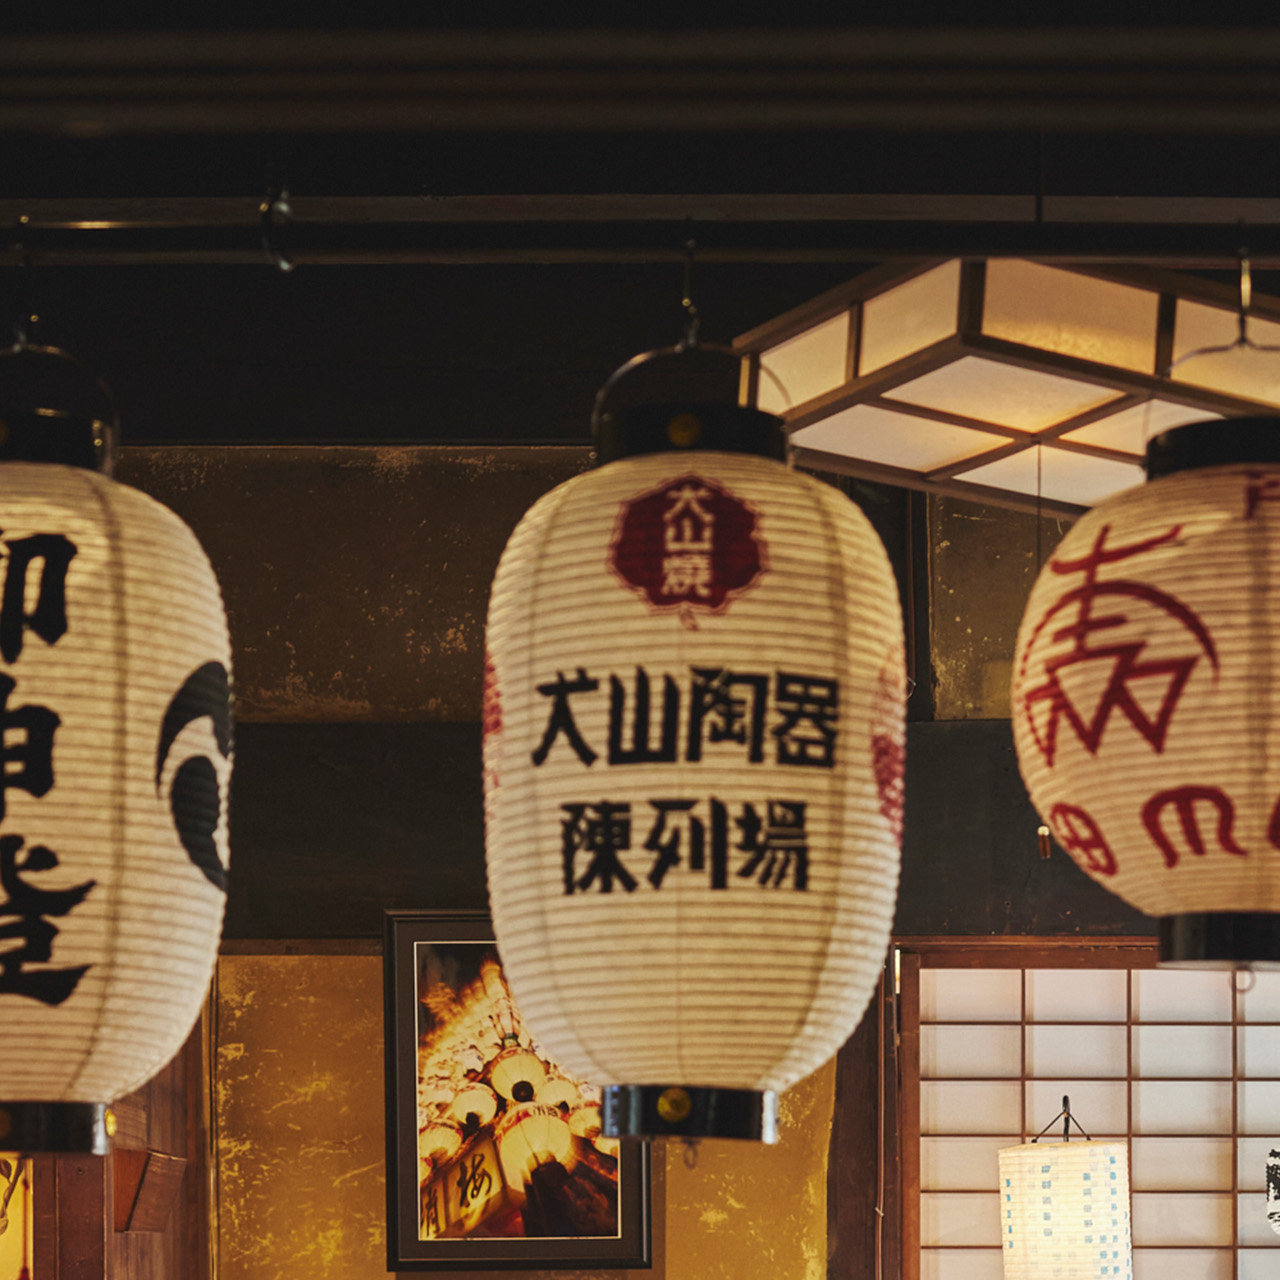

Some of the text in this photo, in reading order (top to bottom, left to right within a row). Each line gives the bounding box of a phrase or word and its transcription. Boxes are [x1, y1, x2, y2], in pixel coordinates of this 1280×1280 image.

[531, 664, 839, 768] 犬山陶器
[560, 796, 810, 896] 陳列場
